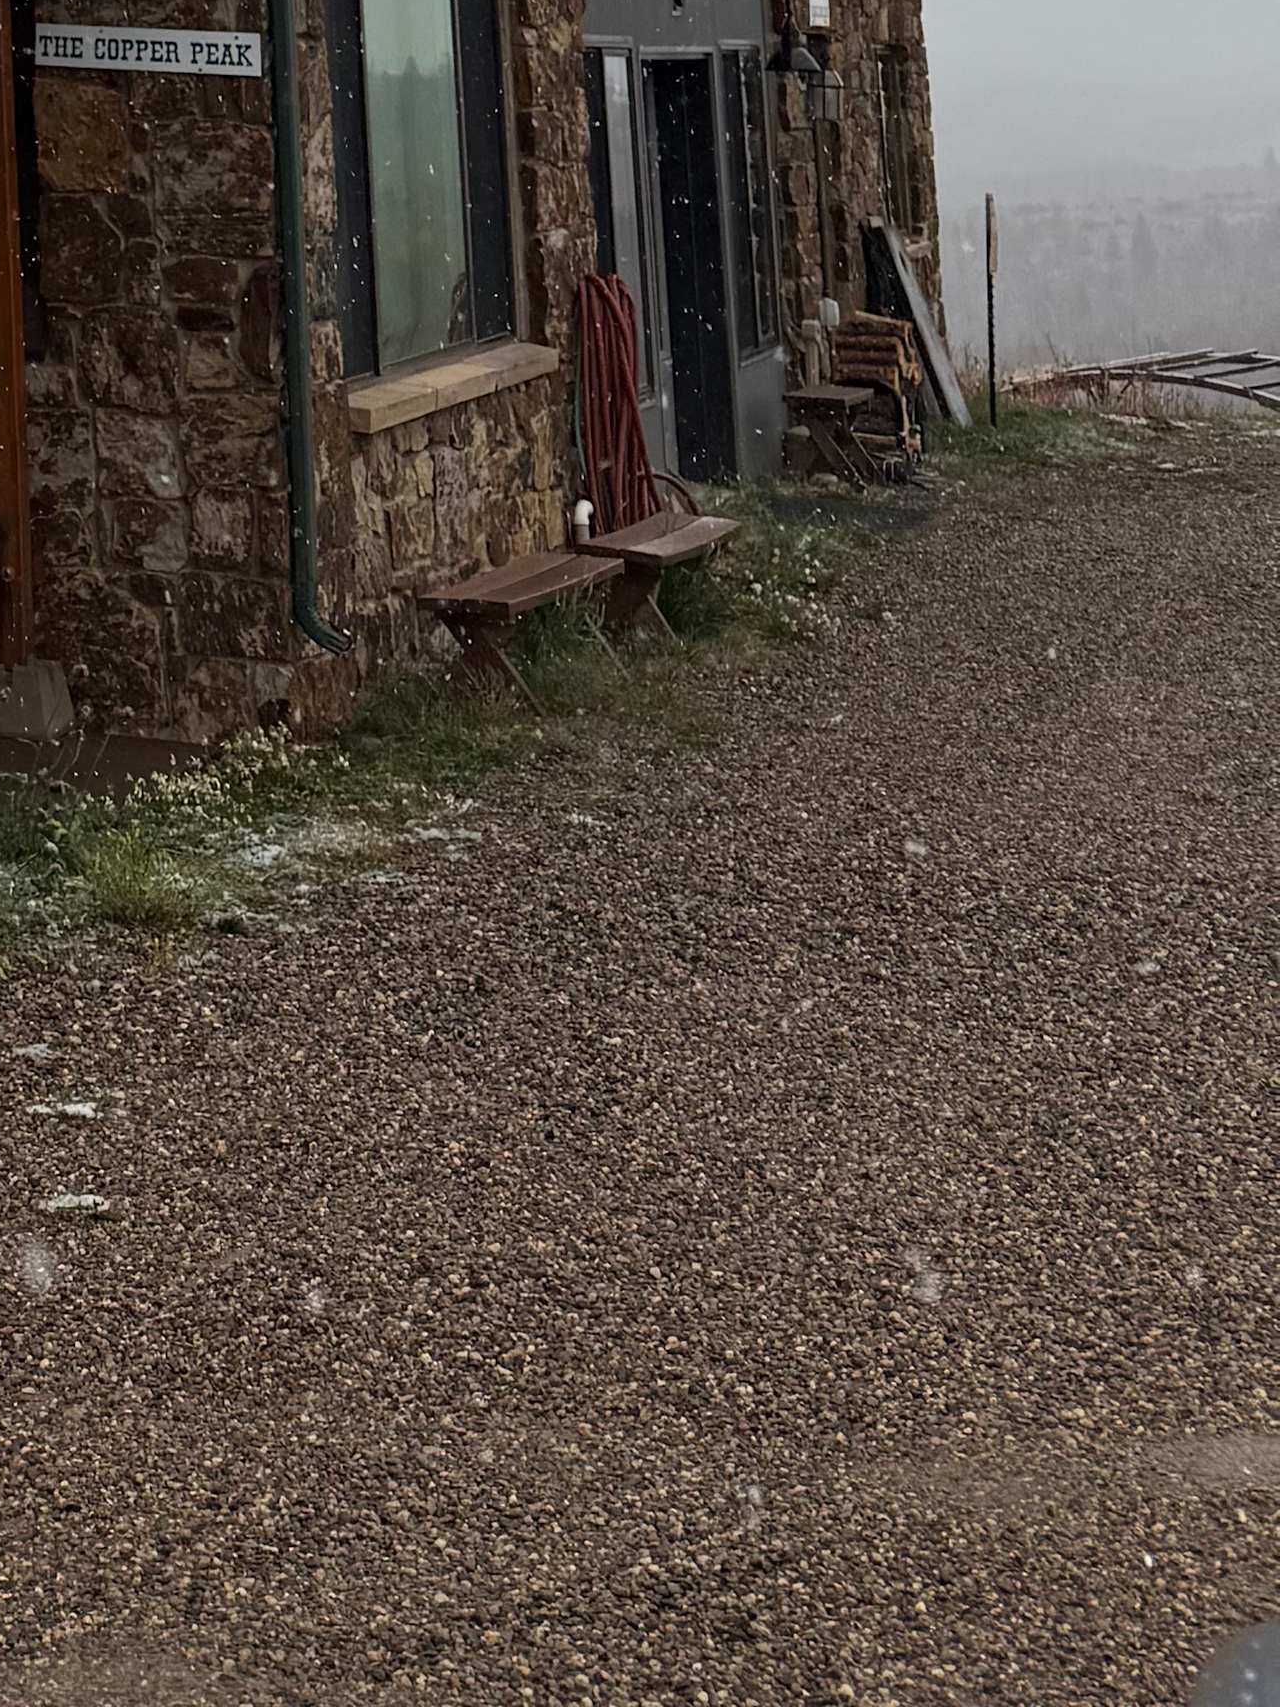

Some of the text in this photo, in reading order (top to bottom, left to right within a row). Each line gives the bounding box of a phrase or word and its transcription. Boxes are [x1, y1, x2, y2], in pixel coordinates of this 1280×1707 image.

[39, 35, 253, 67] THE COPPER PEAK
